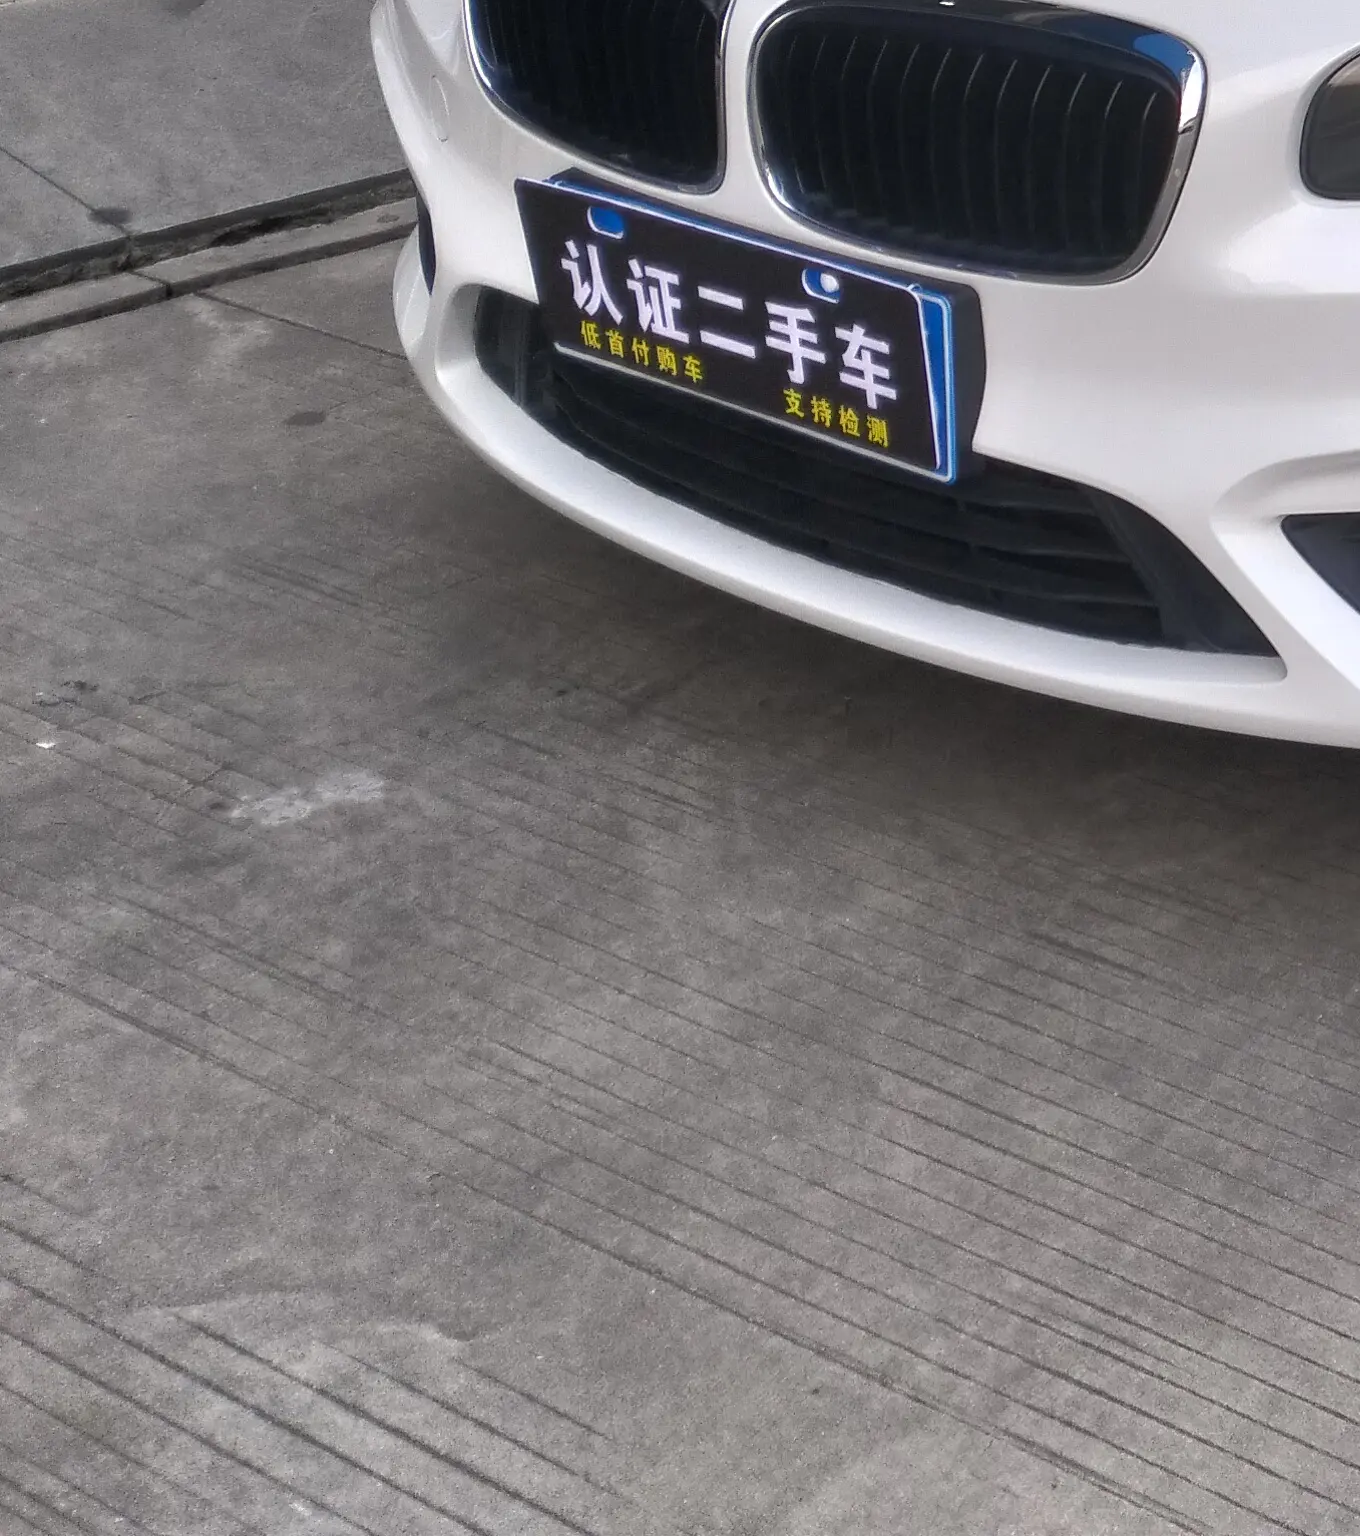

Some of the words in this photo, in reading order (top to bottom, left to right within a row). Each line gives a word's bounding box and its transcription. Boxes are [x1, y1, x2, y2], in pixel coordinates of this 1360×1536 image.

[560, 238, 897, 410] 认证二手车
[579, 319, 704, 383] 低首付购车
[783, 387, 889, 449] 支持检测
